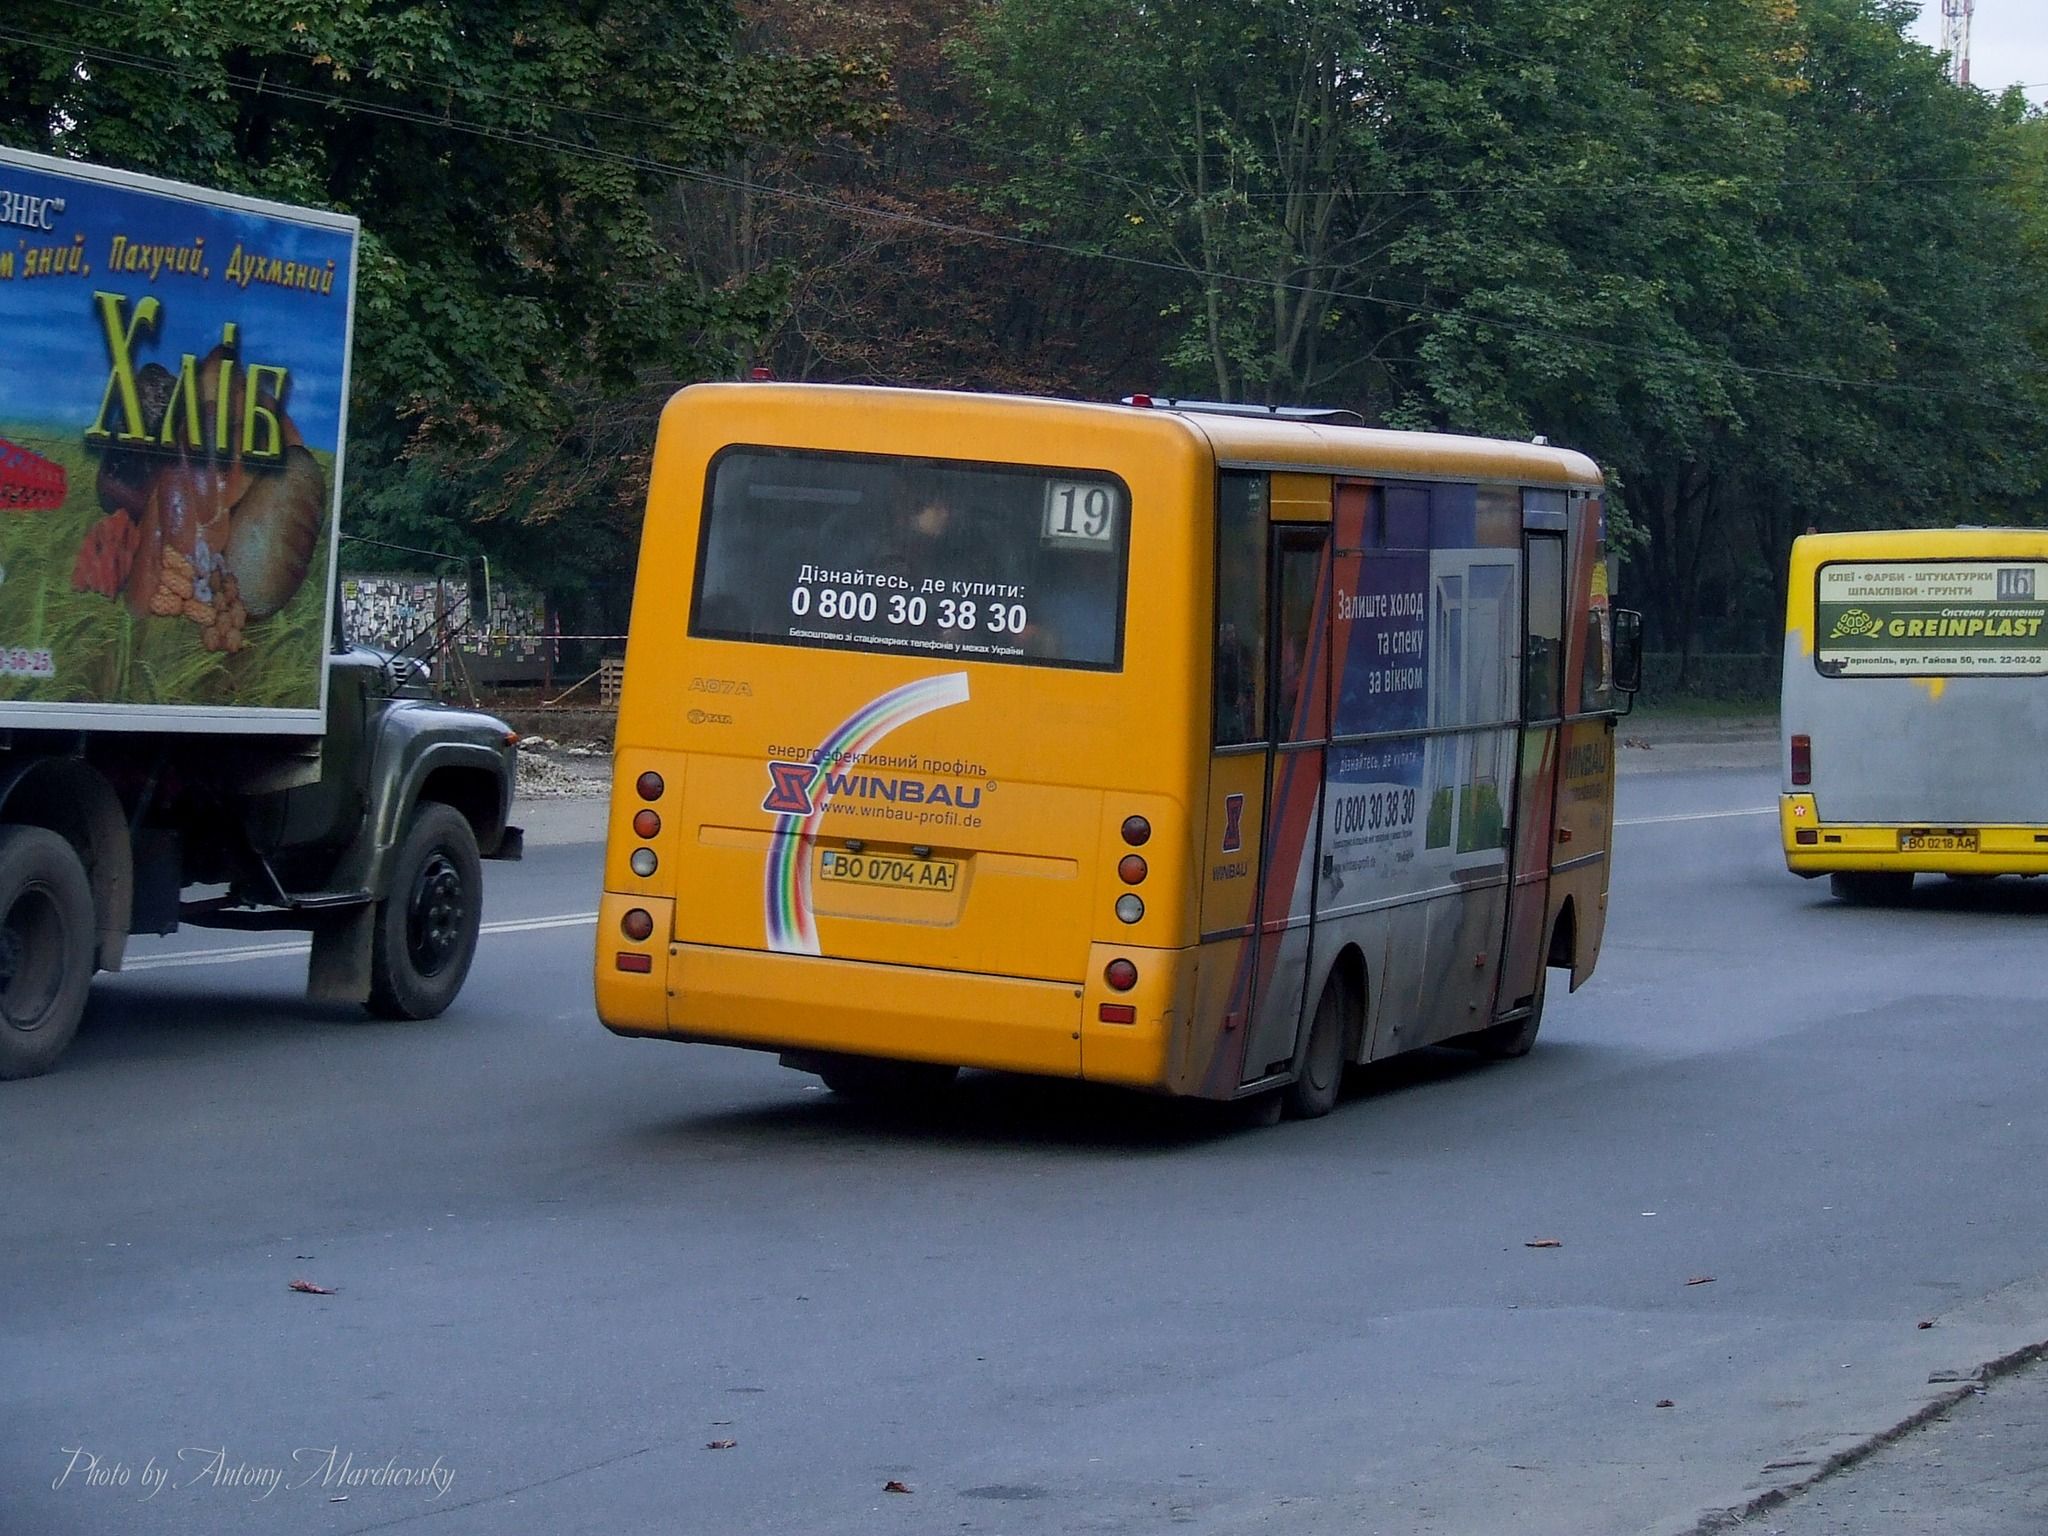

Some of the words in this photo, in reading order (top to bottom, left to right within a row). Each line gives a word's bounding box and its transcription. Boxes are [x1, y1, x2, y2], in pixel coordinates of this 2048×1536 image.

[109, 235, 209, 281] Пахучий,
[224, 244, 336, 295] Духмяний
[1057, 486, 1110, 537] 19
[798, 564, 914, 592] Дізнайтесь,
[921, 578, 945, 594] де
[952, 580, 1025, 598] купити:
[1828, 571, 1856, 582] КЛЕЇ
[1864, 572, 1905, 582] ФАРБИ
[1915, 572, 1993, 582] ШТУКАТУРКИ
[1848, 586, 1918, 597] ШПАКЛІВКИ
[1927, 586, 1973, 596] ГРУНТИ
[792, 586, 811, 616] 0
[818, 588, 877, 622] 800
[887, 594, 927, 626] 30
[937, 599, 977, 631] 38
[987, 602, 1027, 634] 30
[1338, 588, 1387, 620] Залиште
[1390, 592, 1424, 621] холод
[1941, 608, 1985, 617] Системи
[1987, 608, 2045, 618] утеплення
[788, 627, 844, 642] Безкоштовно
[853, 633, 909, 647] стаціонарних
[910, 638, 954, 651] телефонів
[955, 643, 961, 653] у
[962, 644, 990, 654] межах
[991, 643, 1025, 656] України
[1888, 618, 2043, 637] GREINPLAST
[1377, 631, 1389, 655] та
[1392, 629, 1424, 660] спеку
[1368, 671, 1380, 694] за
[1384, 660, 1423, 693] вікном
[1899, 657, 1920, 667] вул.
[1999, 656, 2042, 665] 22-02-02
[767, 744, 918, 771] енергоефективний
[921, 754, 988, 777] профіль
[825, 772, 982, 810] WINBAU
[820, 800, 983, 829] www.winbau-profil.de
[1335, 797, 1343, 835] 0
[1345, 794, 1366, 834] 800
[1368, 792, 1382, 830] 30
[1384, 790, 1399, 828] 38
[1401, 787, 1415, 825] 30
[868, 859, 915, 883] 0704
[918, 863, 948, 887] AA
